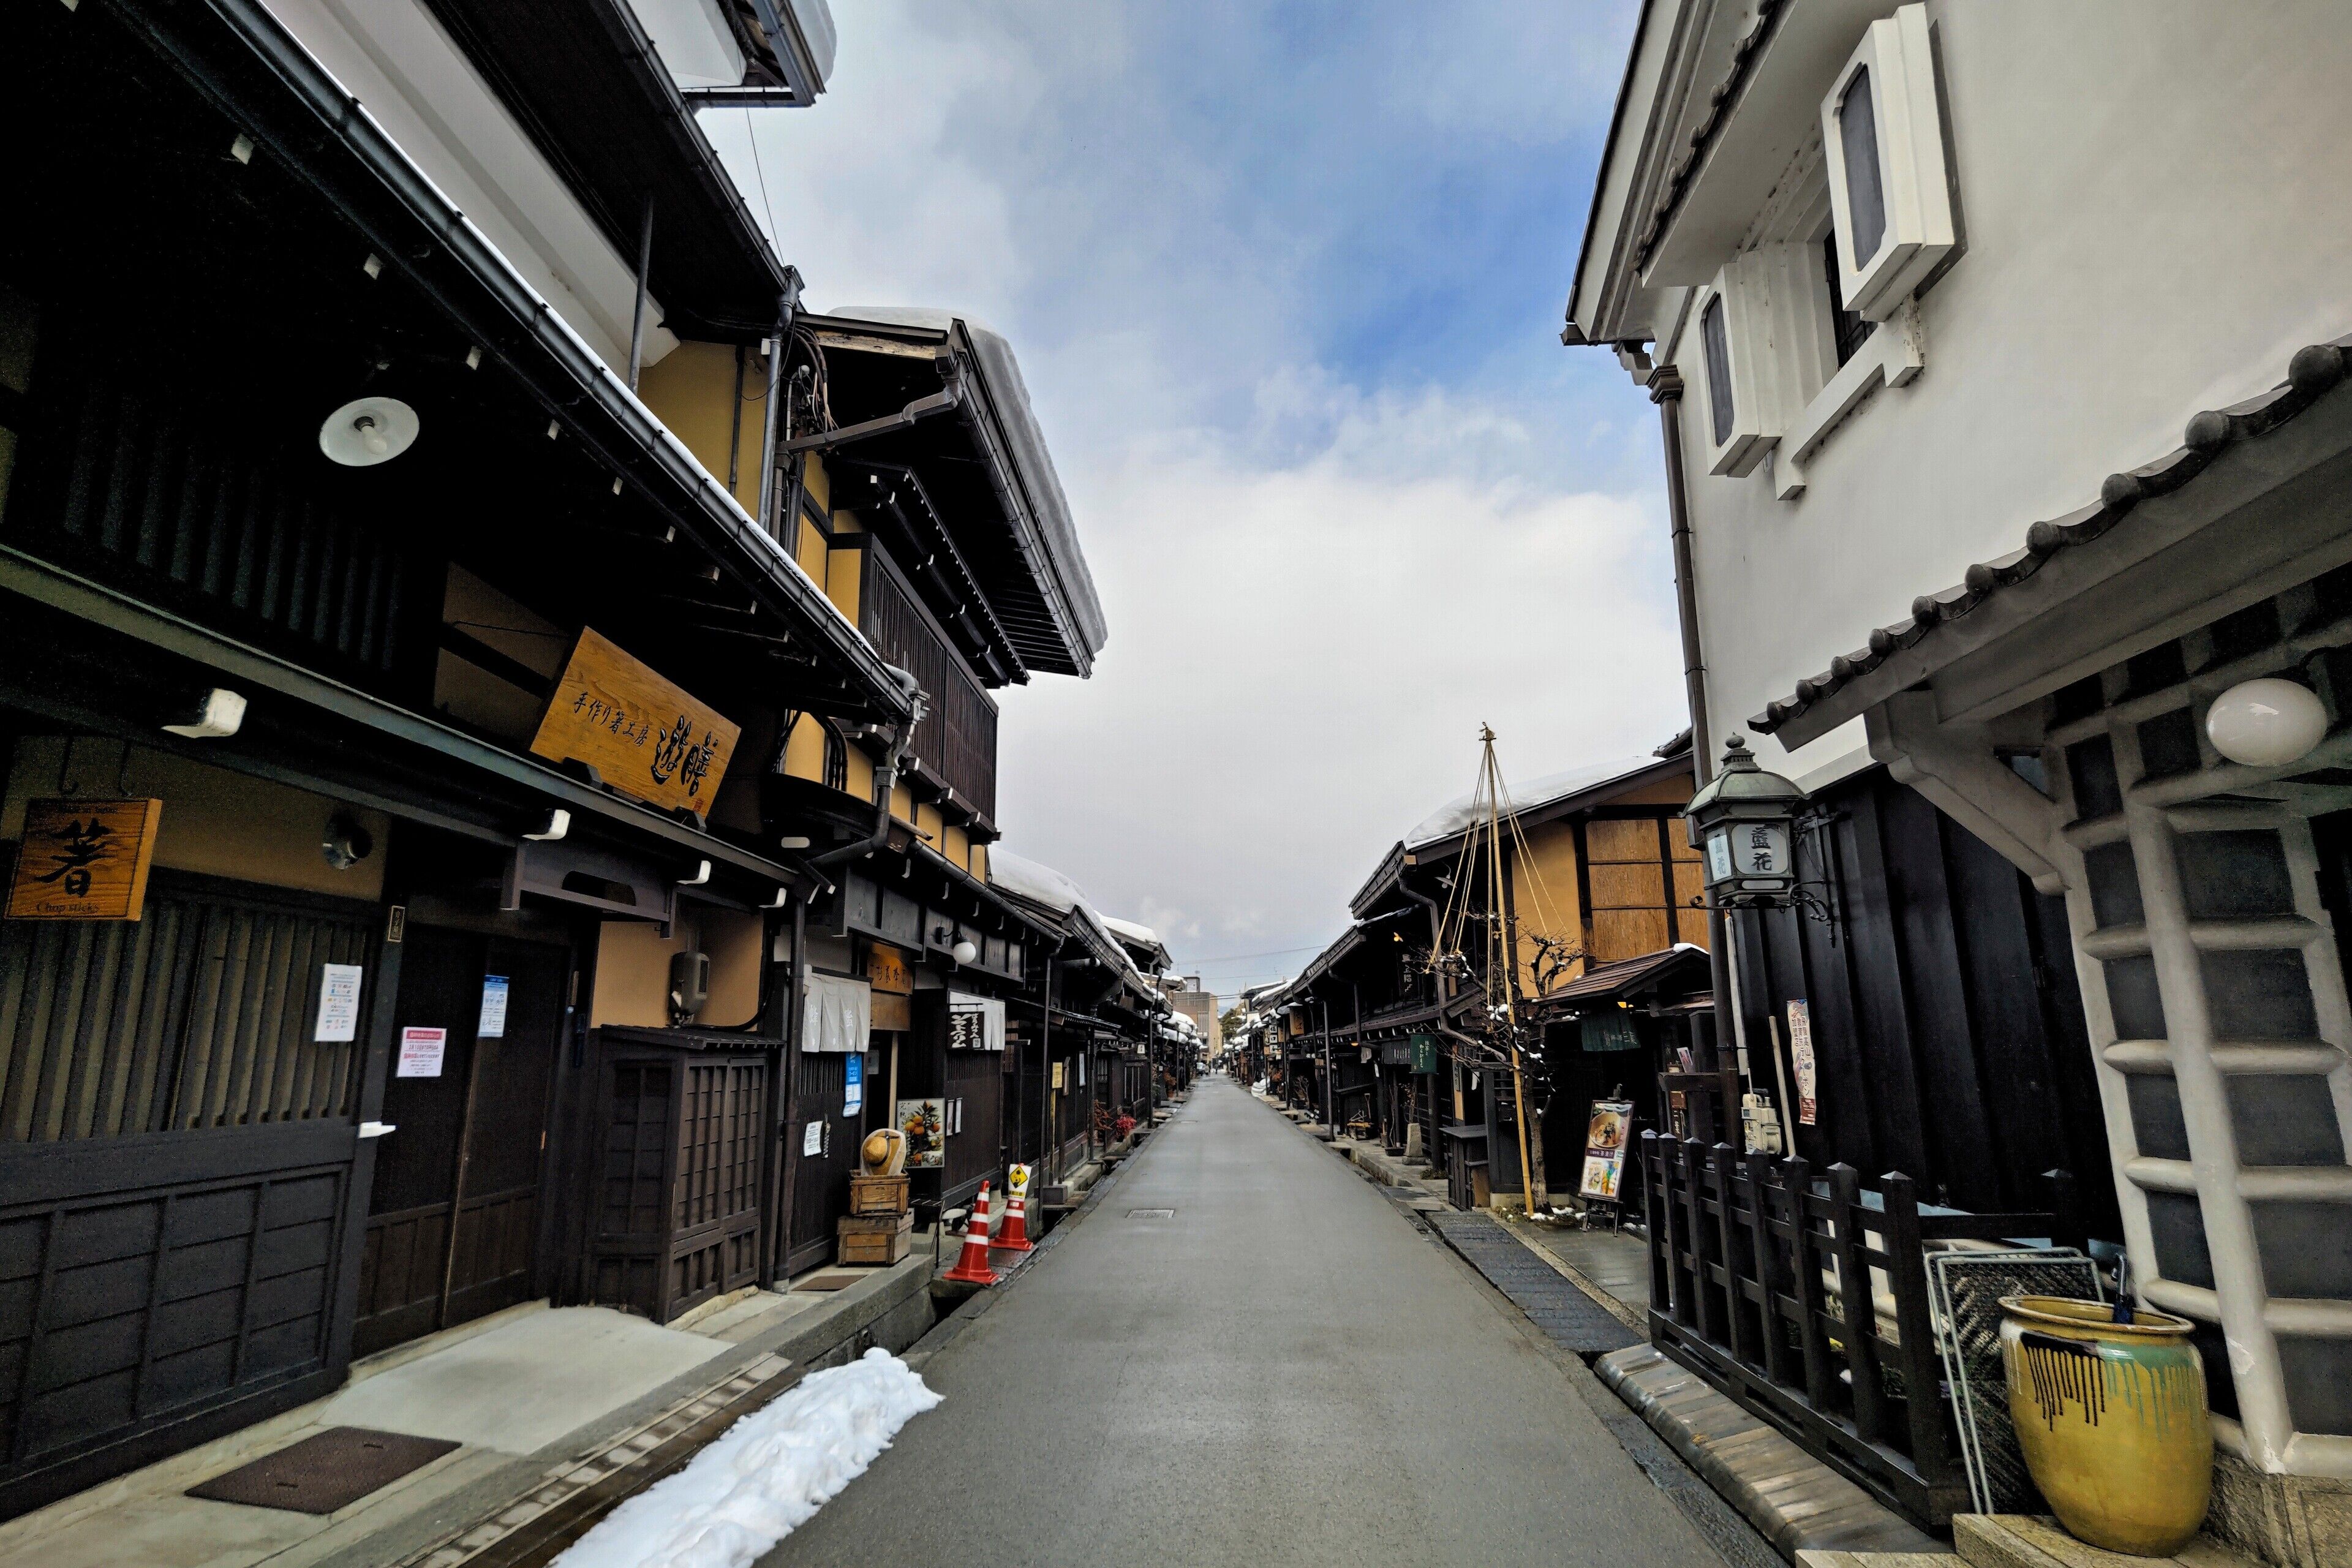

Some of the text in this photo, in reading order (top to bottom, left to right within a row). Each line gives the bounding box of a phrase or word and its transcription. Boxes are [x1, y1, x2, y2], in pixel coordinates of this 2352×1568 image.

[574, 691, 649, 747] 手作り箸工房
[34, 818, 118, 897] 箸
[1751, 827, 1773, 871] 藍花
